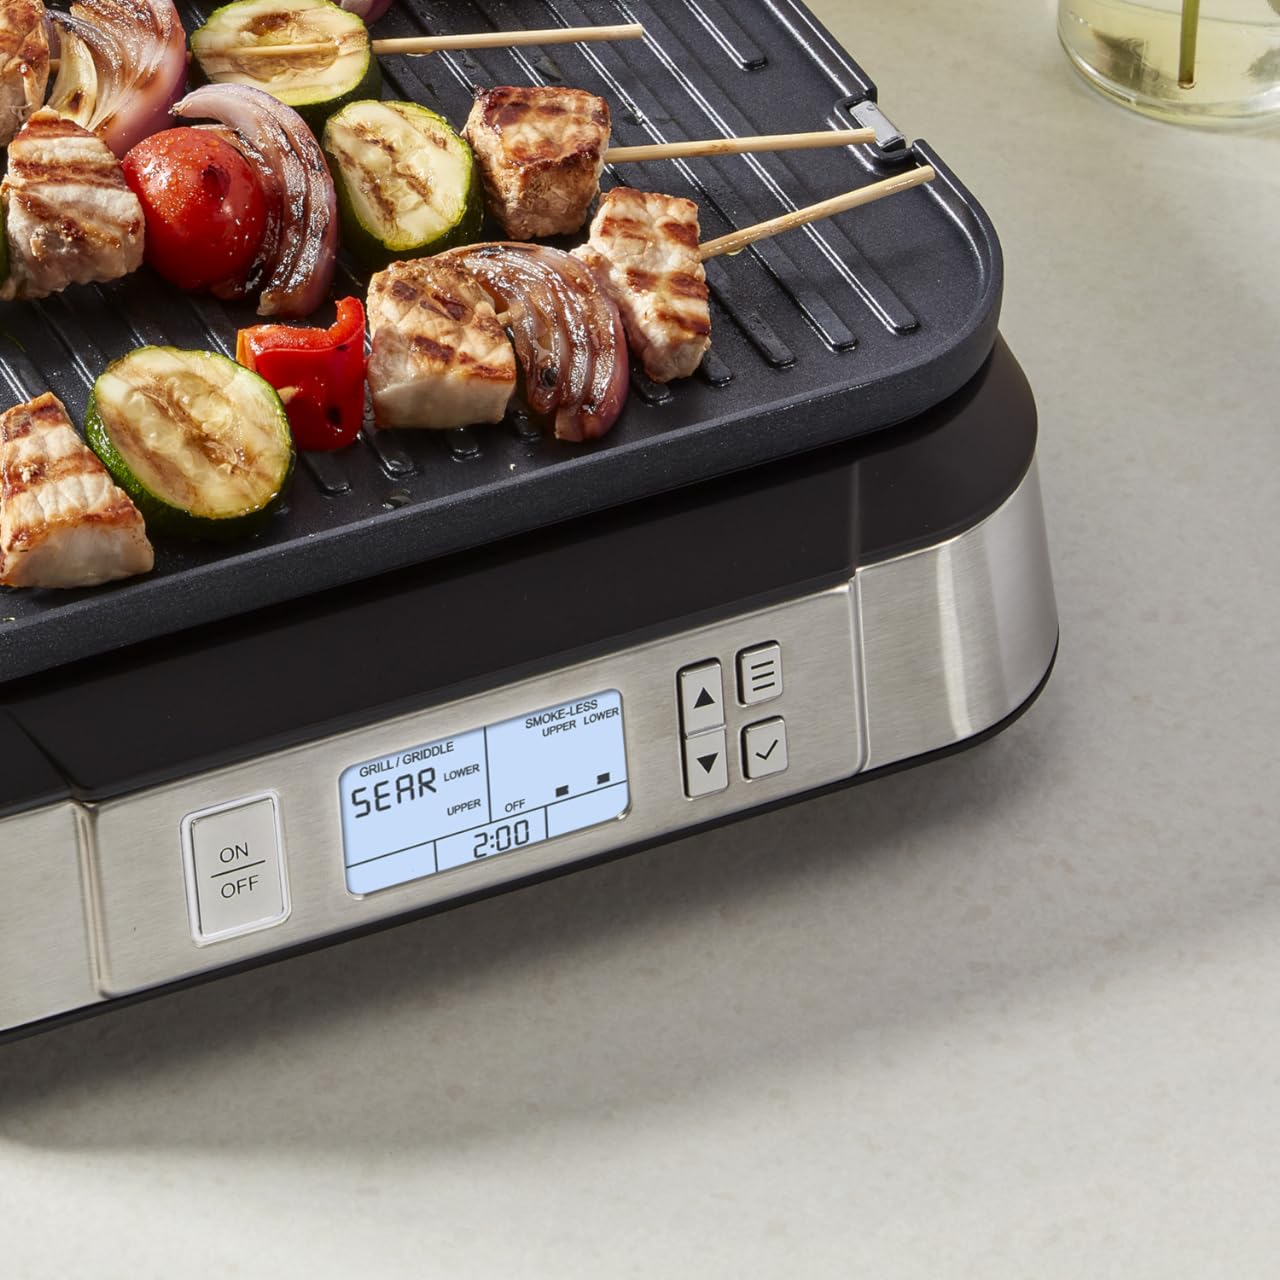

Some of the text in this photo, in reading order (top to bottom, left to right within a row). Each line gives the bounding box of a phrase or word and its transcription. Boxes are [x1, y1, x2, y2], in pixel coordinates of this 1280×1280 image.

[525, 699, 599, 730] SMOKE-LESS
[542, 707, 620, 737] UPPER LOWER
[359, 759, 394, 778] GRILL
[402, 741, 455, 765] GRIDDLE
[443, 764, 480, 782] LOWER
[351, 767, 438, 819] SEAR
[505, 799, 526, 813] OFF
[447, 799, 482, 816] UPPER
[219, 842, 249, 863] ON
[473, 819, 530, 859] 2:00
[221, 874, 259, 899] OFF
